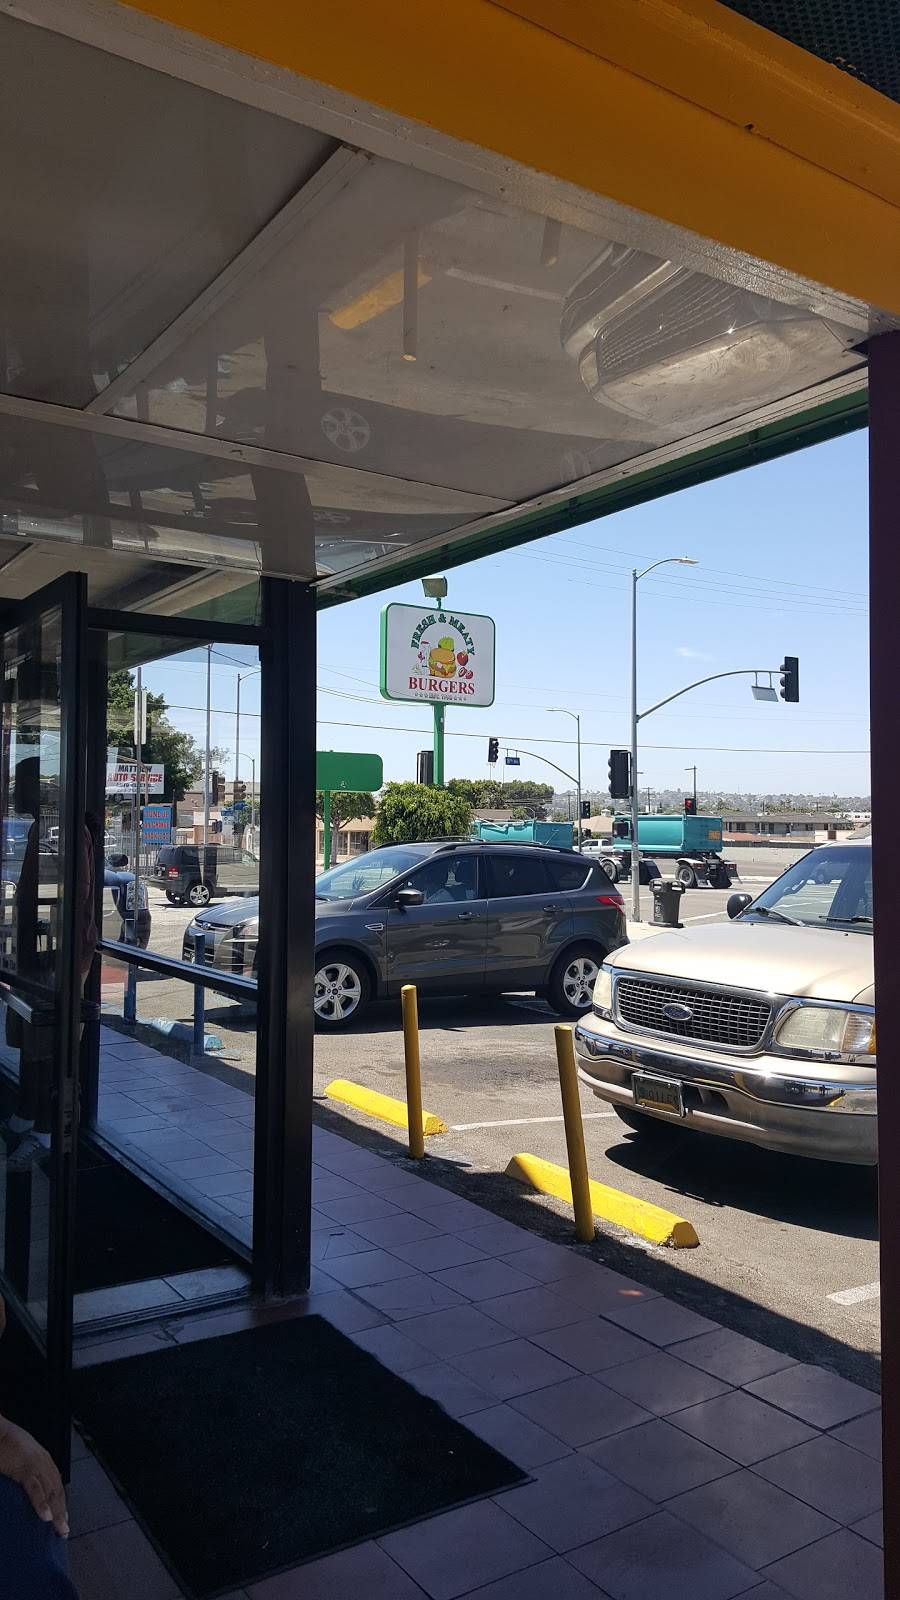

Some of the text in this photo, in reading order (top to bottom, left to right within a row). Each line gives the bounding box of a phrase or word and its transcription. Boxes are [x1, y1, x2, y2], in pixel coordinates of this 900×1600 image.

[411, 613, 476, 656] FRESH & MEATY
[408, 676, 475, 695] BURGERS
